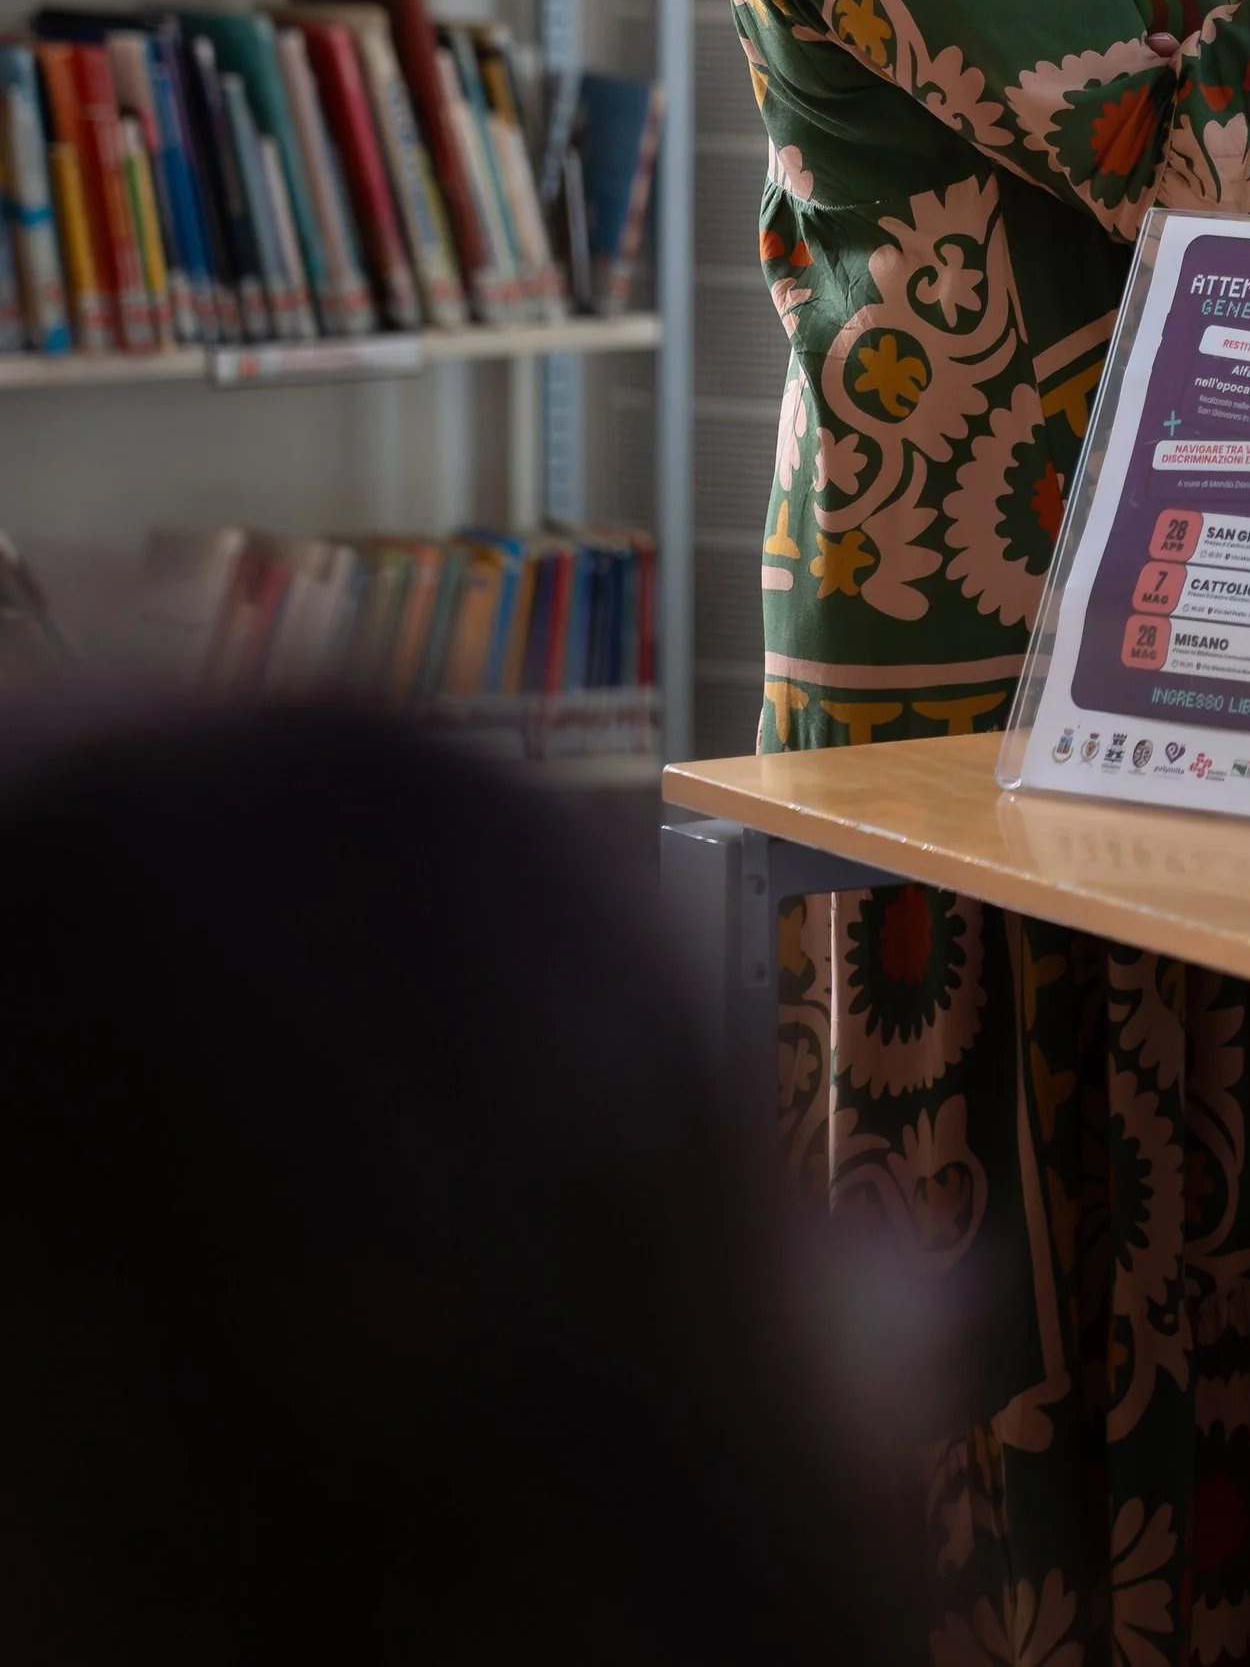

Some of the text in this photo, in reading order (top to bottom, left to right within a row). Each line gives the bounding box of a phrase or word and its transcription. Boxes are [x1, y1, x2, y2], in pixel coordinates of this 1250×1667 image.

[1194, 376, 1250, 395] nell'epoca
[1175, 444, 1224, 455] NAVIGARE
[1226, 444, 1244, 455] TRA
[1161, 454, 1244, 465] DISCRIMINAZIONI
[1245, 455, 1250, 465] E
[1166, 519, 1188, 541] 28
[1206, 526, 1237, 541] SAN
[1160, 541, 1185, 552] APR
[1153, 571, 1168, 592] 7
[1141, 593, 1170, 605] MAG
[1174, 633, 1230, 651] MISANO
[1130, 647, 1157, 660] MAG
[1151, 686, 1224, 712] INGRESSO
